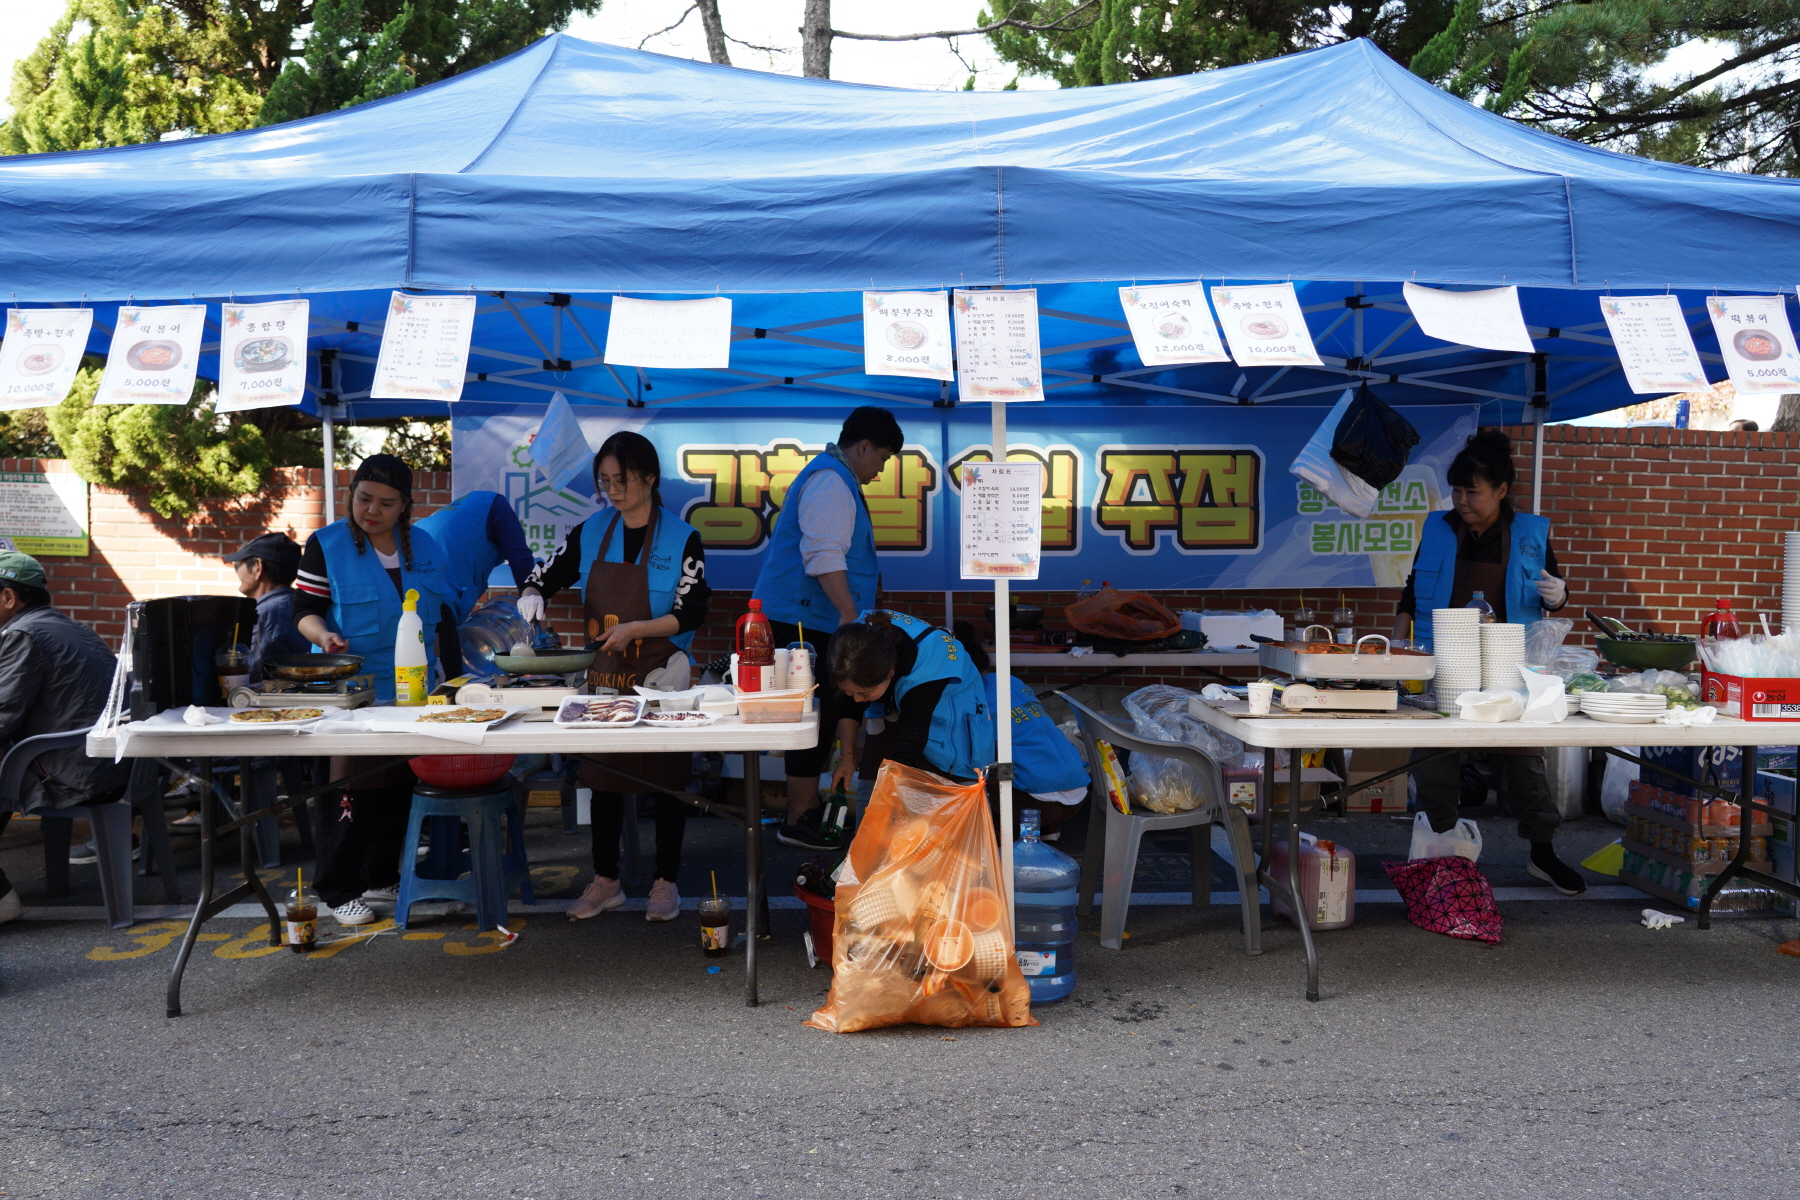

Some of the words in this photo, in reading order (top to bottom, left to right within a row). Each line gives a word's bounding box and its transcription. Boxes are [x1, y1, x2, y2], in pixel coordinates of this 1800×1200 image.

[1138, 300, 1170, 310] 오징어
[1171, 298, 1192, 309] 숙회
[878, 308, 934, 318] 해물부추전
[139, 323, 181, 335] 떡볶이
[245, 320, 287, 333] 홍합탕
[1154, 343, 1205, 353] 12,000원
[1247, 344, 1297, 354] 10,000원
[885, 354, 930, 364] 8,000원
[1746, 367, 1788, 378] 5,000원
[6, 382, 55, 394] 10,000원
[123, 378, 171, 387] 5,000원
[239, 377, 283, 390] 7,000원
[1099, 450, 1259, 550] 주점
[1299, 481, 1427, 513] 행전소
[1311, 522, 1414, 554] 봉사모임
[589, 670, 637, 689] COOKING
[1766, 693, 1787, 702] 농심
